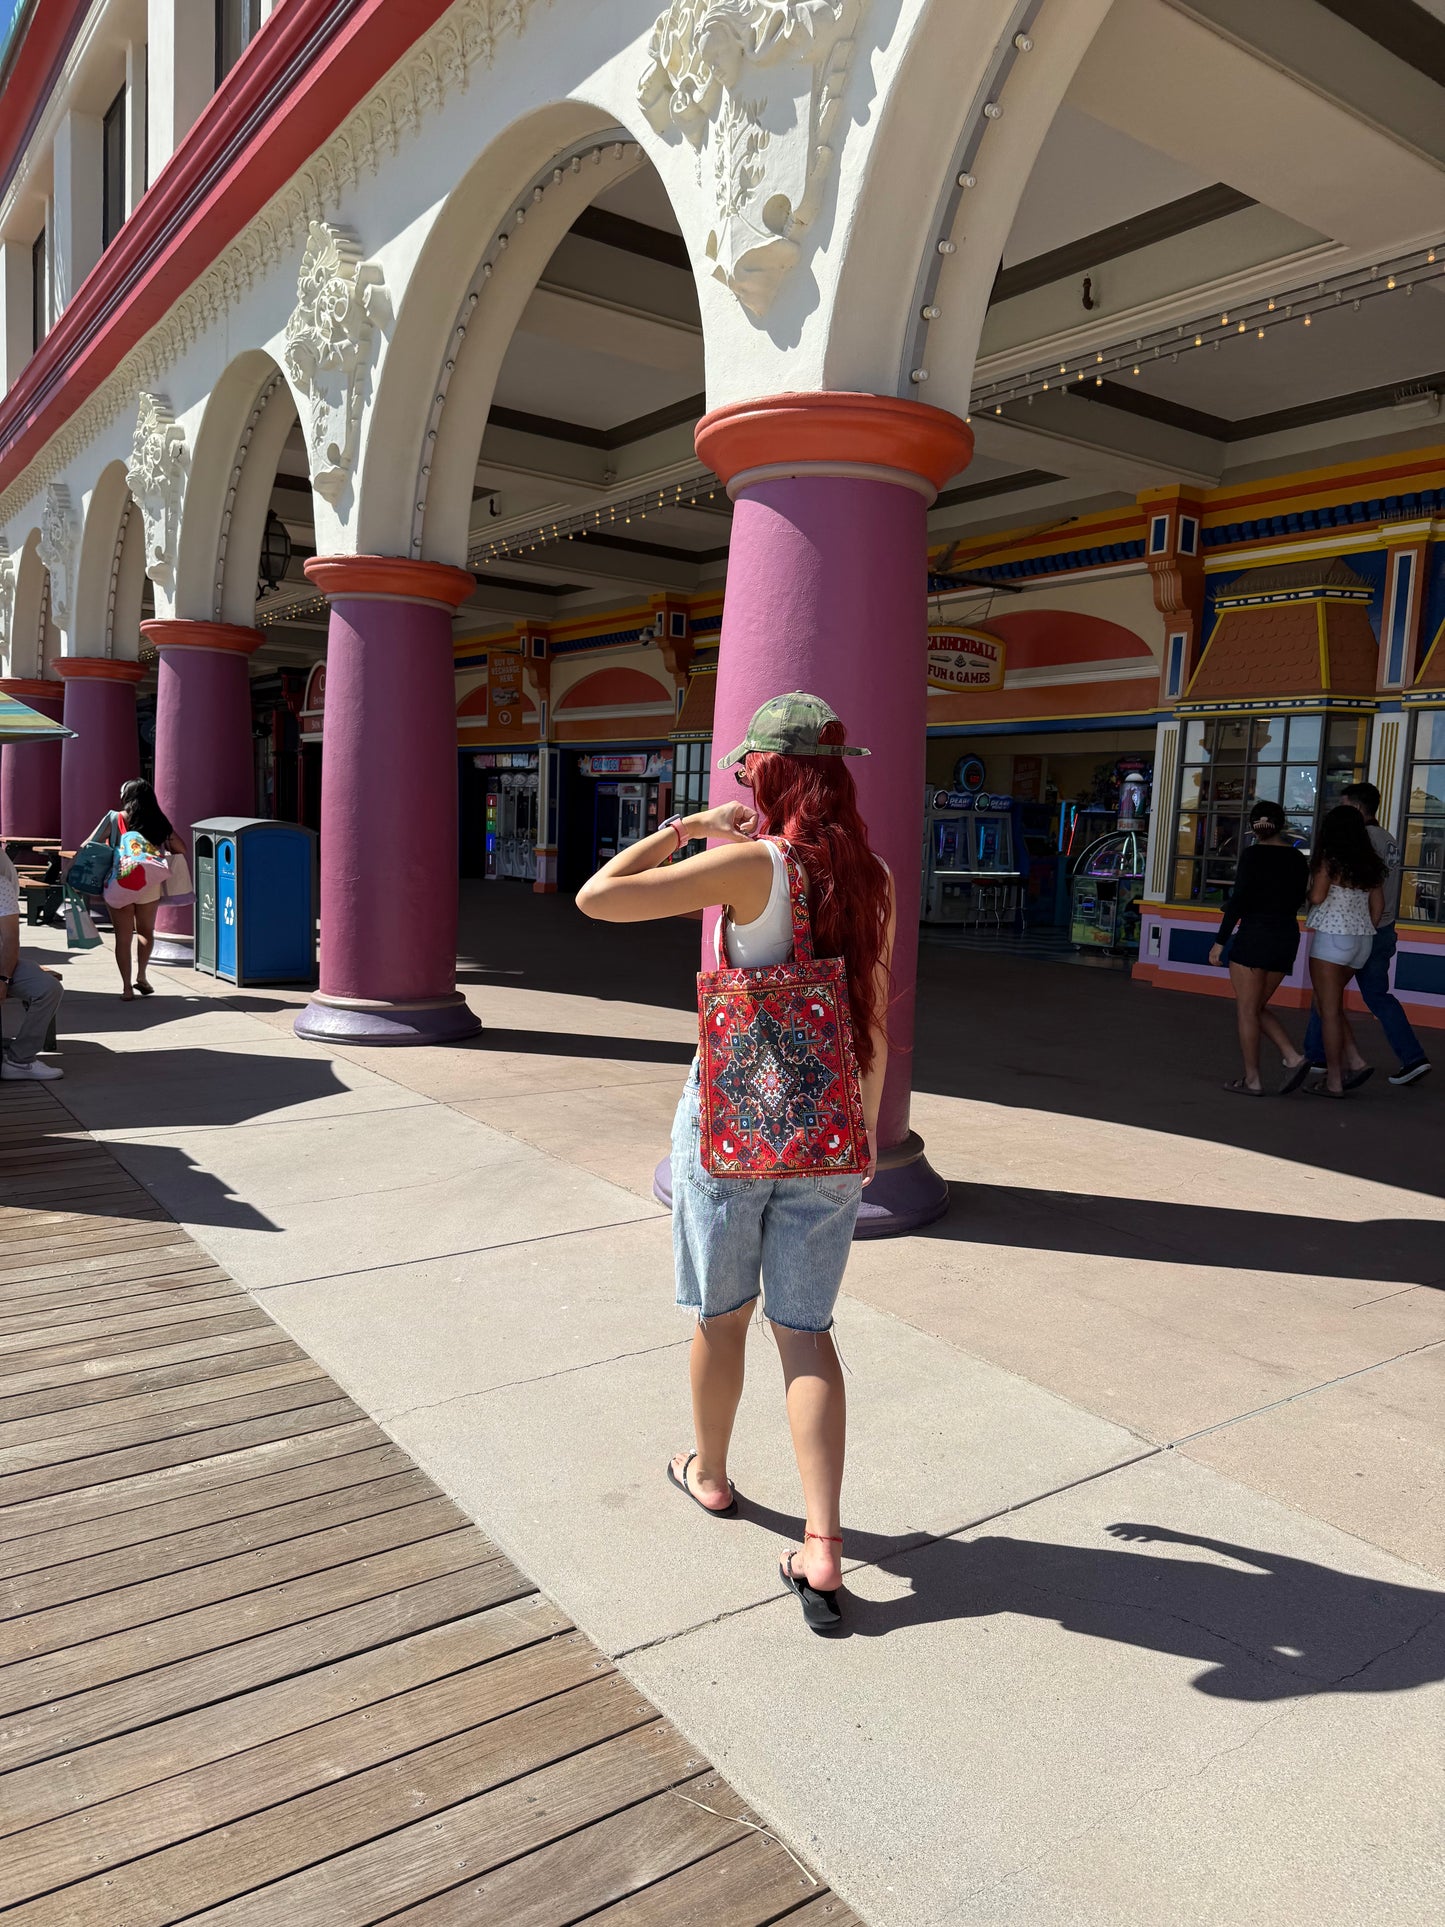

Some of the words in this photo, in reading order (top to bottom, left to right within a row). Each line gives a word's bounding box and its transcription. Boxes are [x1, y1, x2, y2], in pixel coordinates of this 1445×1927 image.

[928, 664, 948, 680] FUN
[949, 671, 955, 681] &
[956, 671, 990, 684] GAMES
